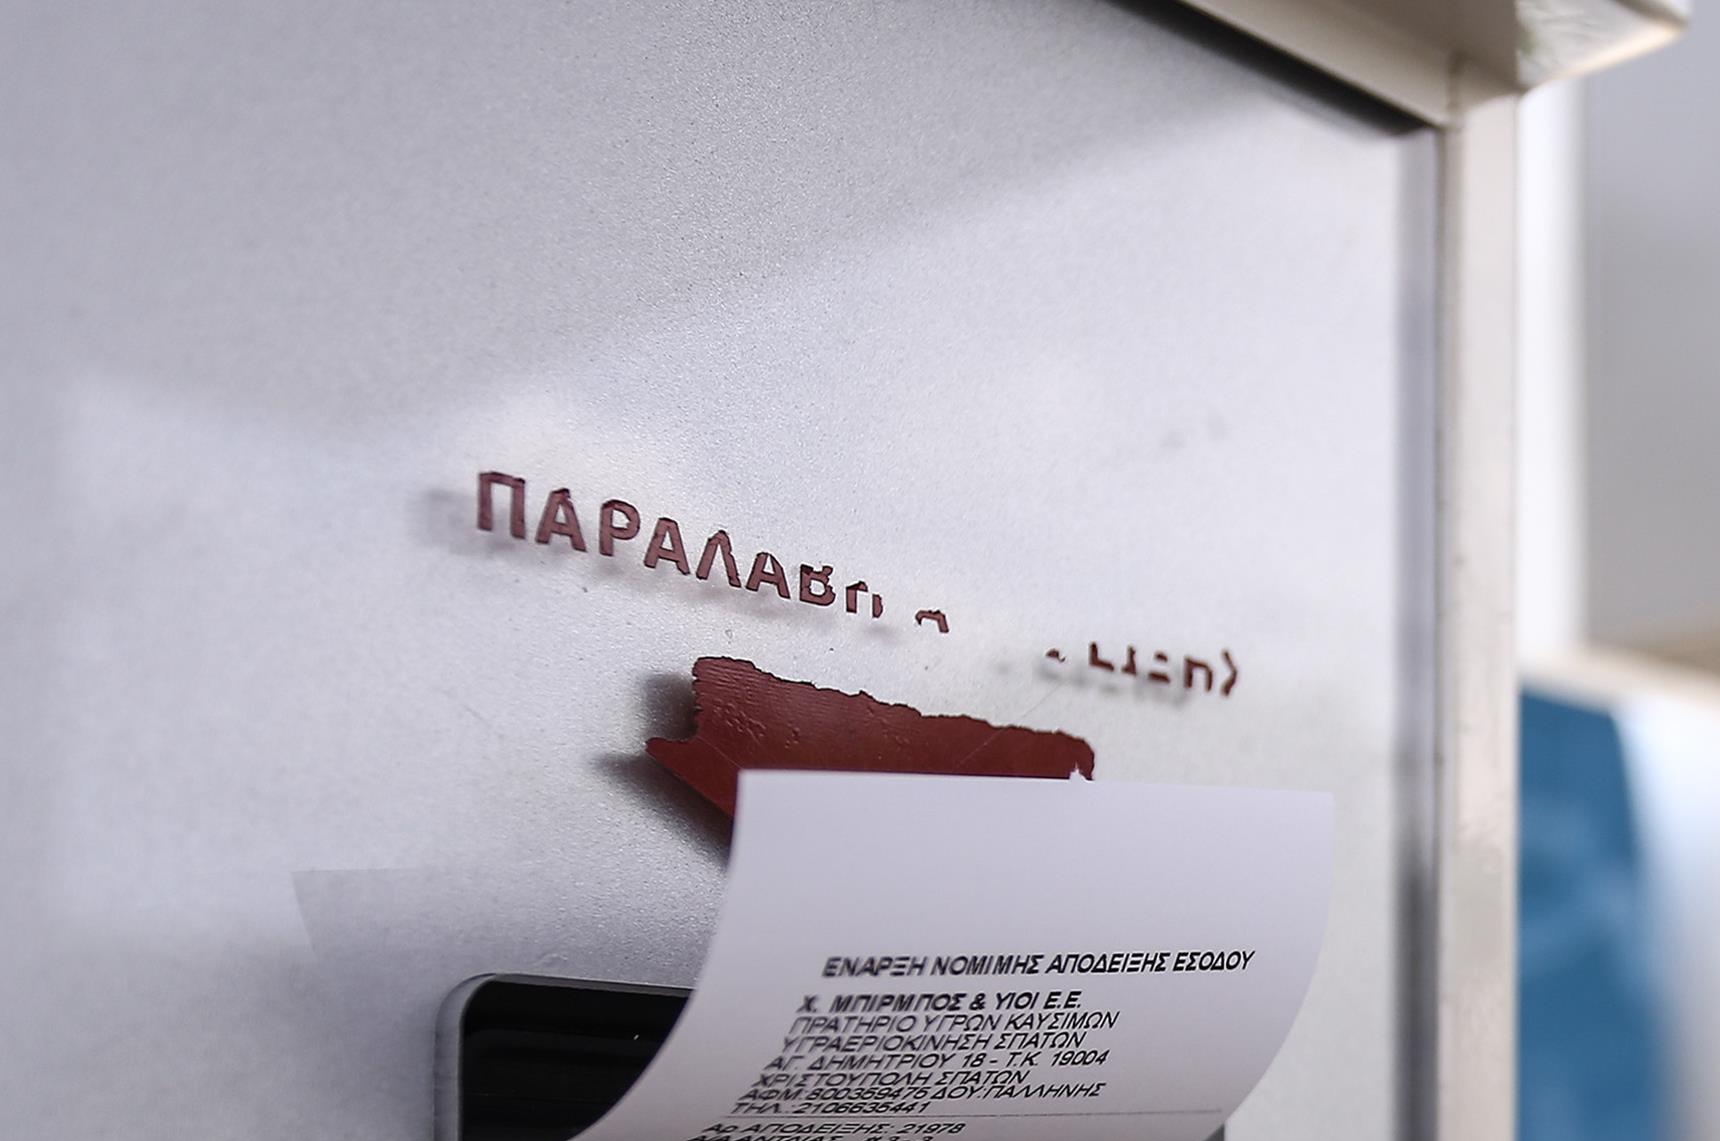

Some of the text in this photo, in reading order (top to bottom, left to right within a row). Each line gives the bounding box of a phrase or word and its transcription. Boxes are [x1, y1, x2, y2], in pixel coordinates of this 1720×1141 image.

[821, 950, 1255, 978] ΕΝΑΡΞΗ ΝΟΜΙΜΗΣ ΑΠΟΔΕΙΞΗΣ ΕΣΟΔΟΥ
[828, 993, 968, 1013] ΜΠΙΡΜΠΟΣ
[968, 992, 986, 1011] &
[995, 991, 1041, 1011] ΥΙΟΙ
[1043, 990, 1083, 1010] Ε.Ε.
[788, 1011, 1121, 1034] ΠΡΑΤΗΡΙΟ ΥΓΡΩΝ ΚΑΥΣΙΜΩΝ
[782, 1031, 1087, 1053] ΥΓΡΑΕΡΙΟΚΙΝΗΣΗ ΣΠΑΤΩΝ
[806, 1052, 956, 1071] ΔΗΜΗΤΡΙΟΥ
[961, 1052, 987, 1069] 18
[1051, 1049, 1111, 1067] 19004
[751, 1070, 1031, 1088] ΧΡΙΣΤΟΥΠΟΛΗ ΣΠΑΤΩΝ
[739, 1122, 895, 1134] ΑΠΟΔΕΙΞΗΣ:
[897, 1123, 967, 1134] 21978
